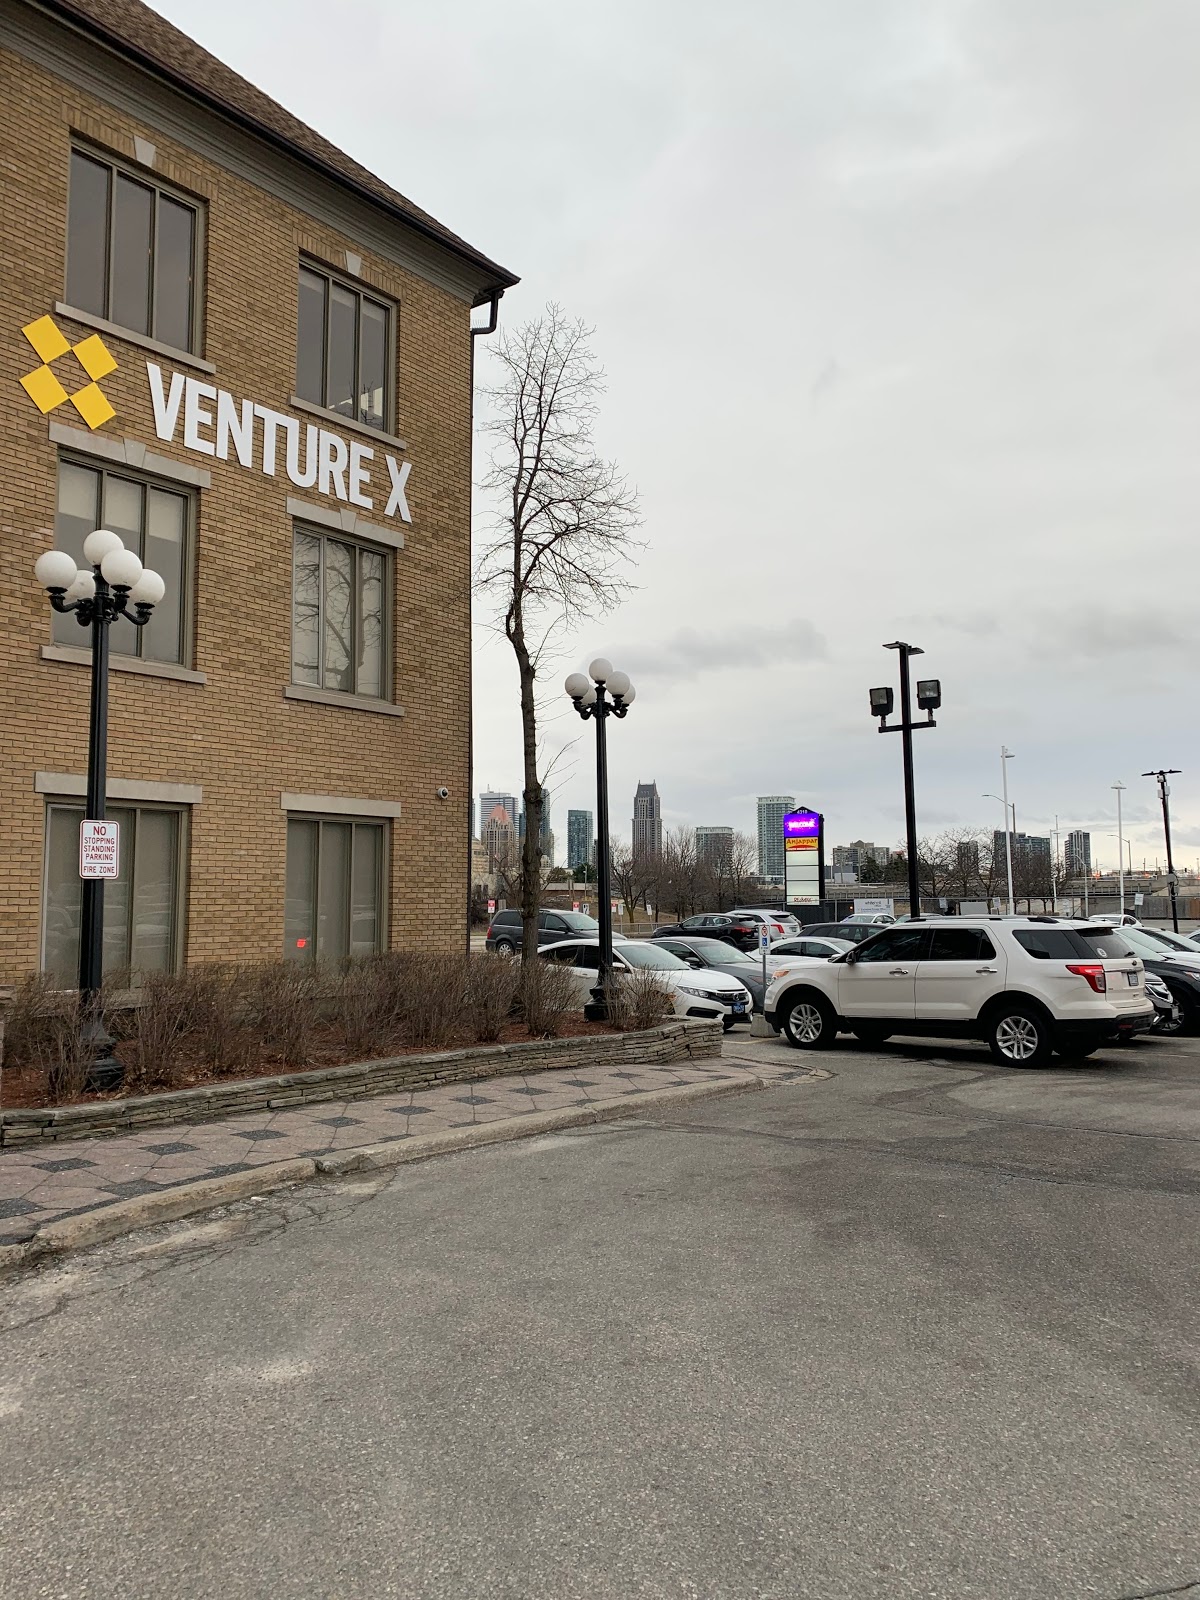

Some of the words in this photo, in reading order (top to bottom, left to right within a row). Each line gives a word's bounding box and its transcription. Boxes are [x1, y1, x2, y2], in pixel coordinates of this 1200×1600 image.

[146, 362, 374, 510] VENTURE
[384, 454, 412, 523] X
[93, 825, 107, 836] NO
[84, 837, 115, 845] STOPPING
[83, 845, 115, 853] STANDING
[85, 853, 114, 861] PARKING
[99, 866, 115, 874] ZONE
